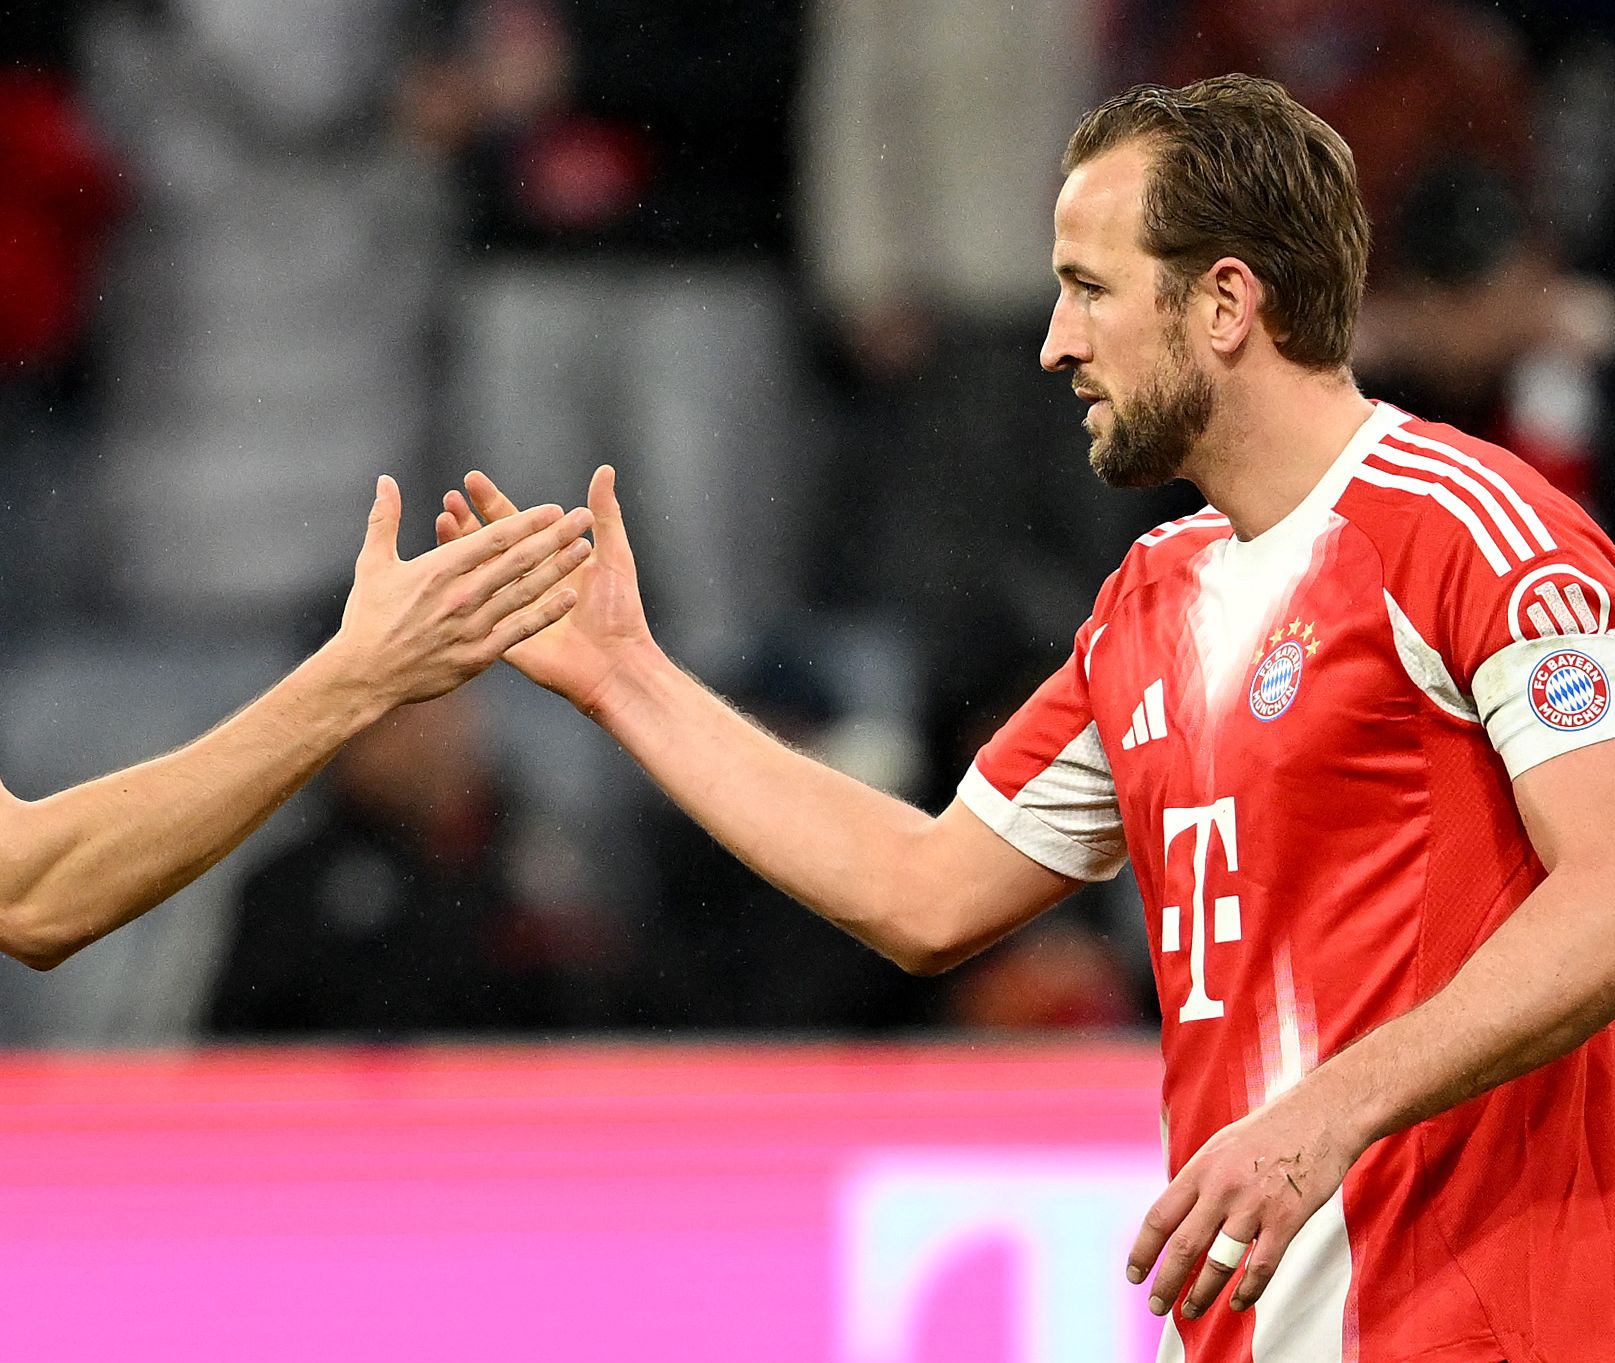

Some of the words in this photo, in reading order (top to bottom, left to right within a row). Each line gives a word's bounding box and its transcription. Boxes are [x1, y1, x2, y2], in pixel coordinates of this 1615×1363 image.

[1534, 669, 1549, 691] FC
[1545, 654, 1602, 683] BAYERN
[1161, 796, 1242, 1023] T
